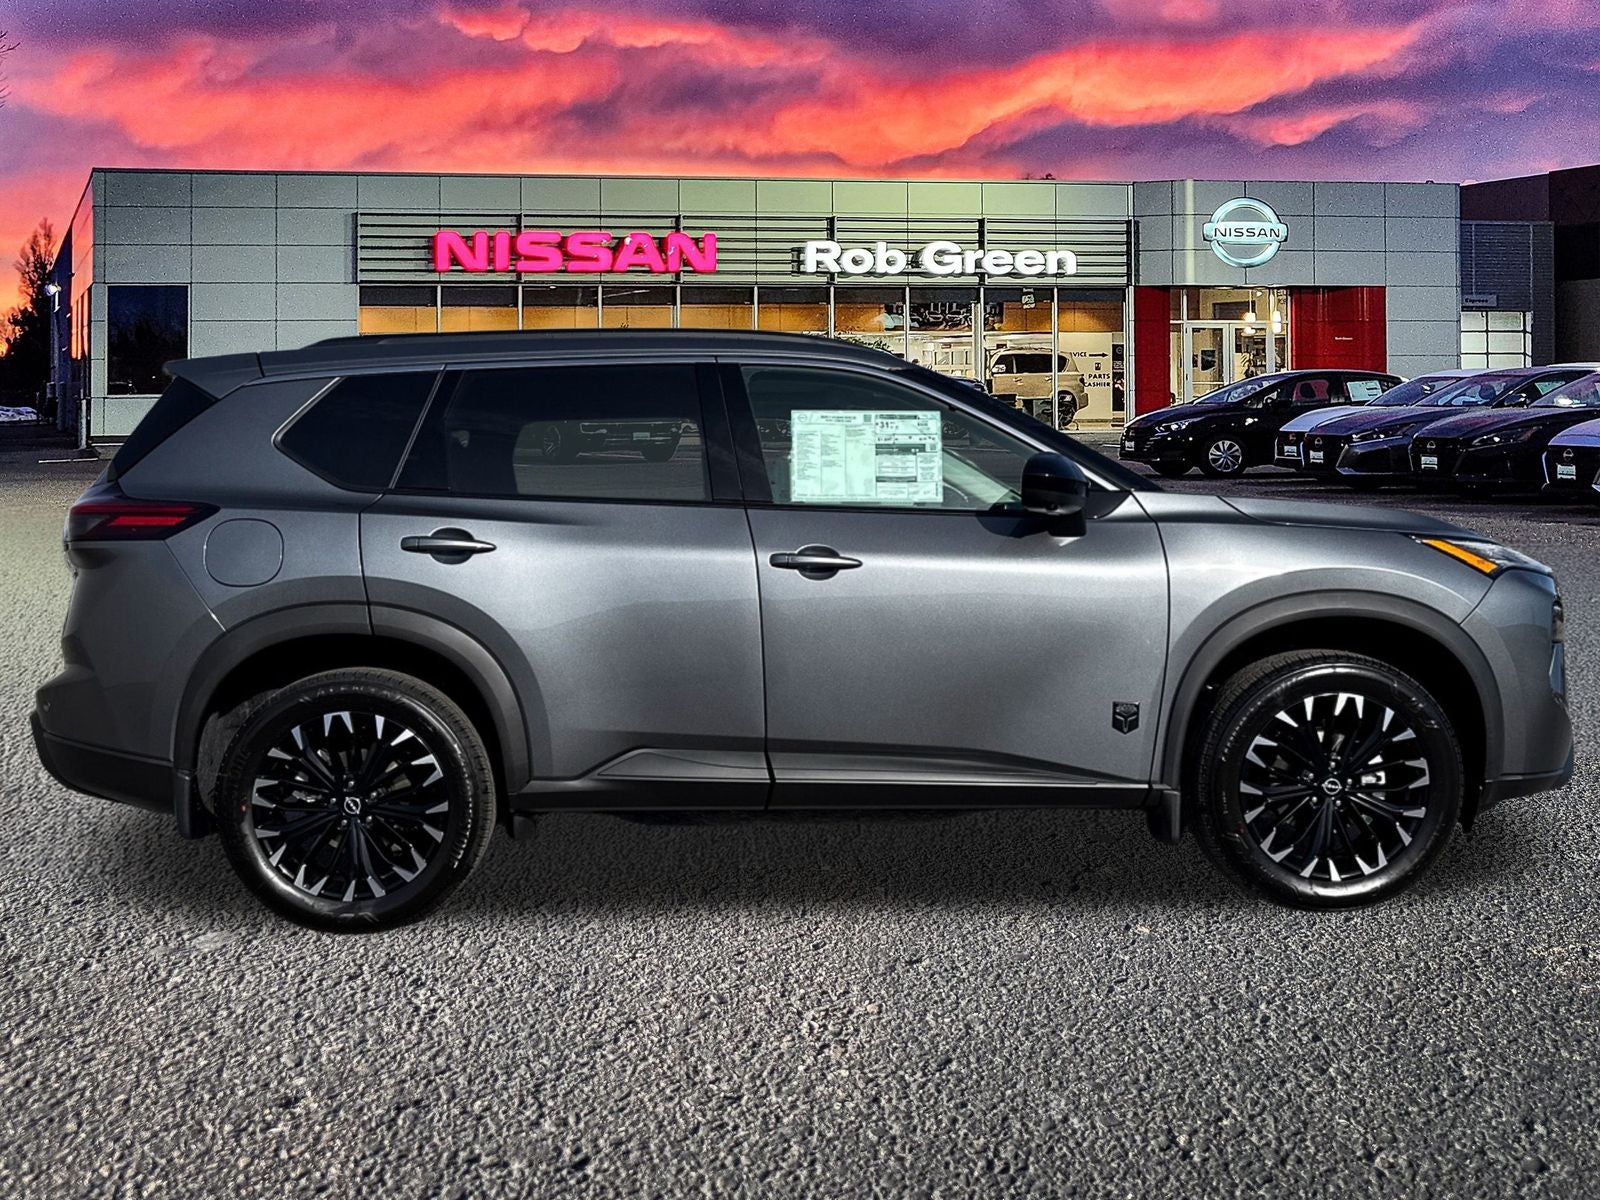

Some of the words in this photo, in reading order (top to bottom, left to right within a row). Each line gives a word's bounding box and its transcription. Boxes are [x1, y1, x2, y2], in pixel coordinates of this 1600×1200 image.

[1214, 227, 1280, 238] NISSAN
[433, 230, 717, 273] NISSAN
[805, 240, 907, 275] Rob
[921, 240, 1077, 275] Green
